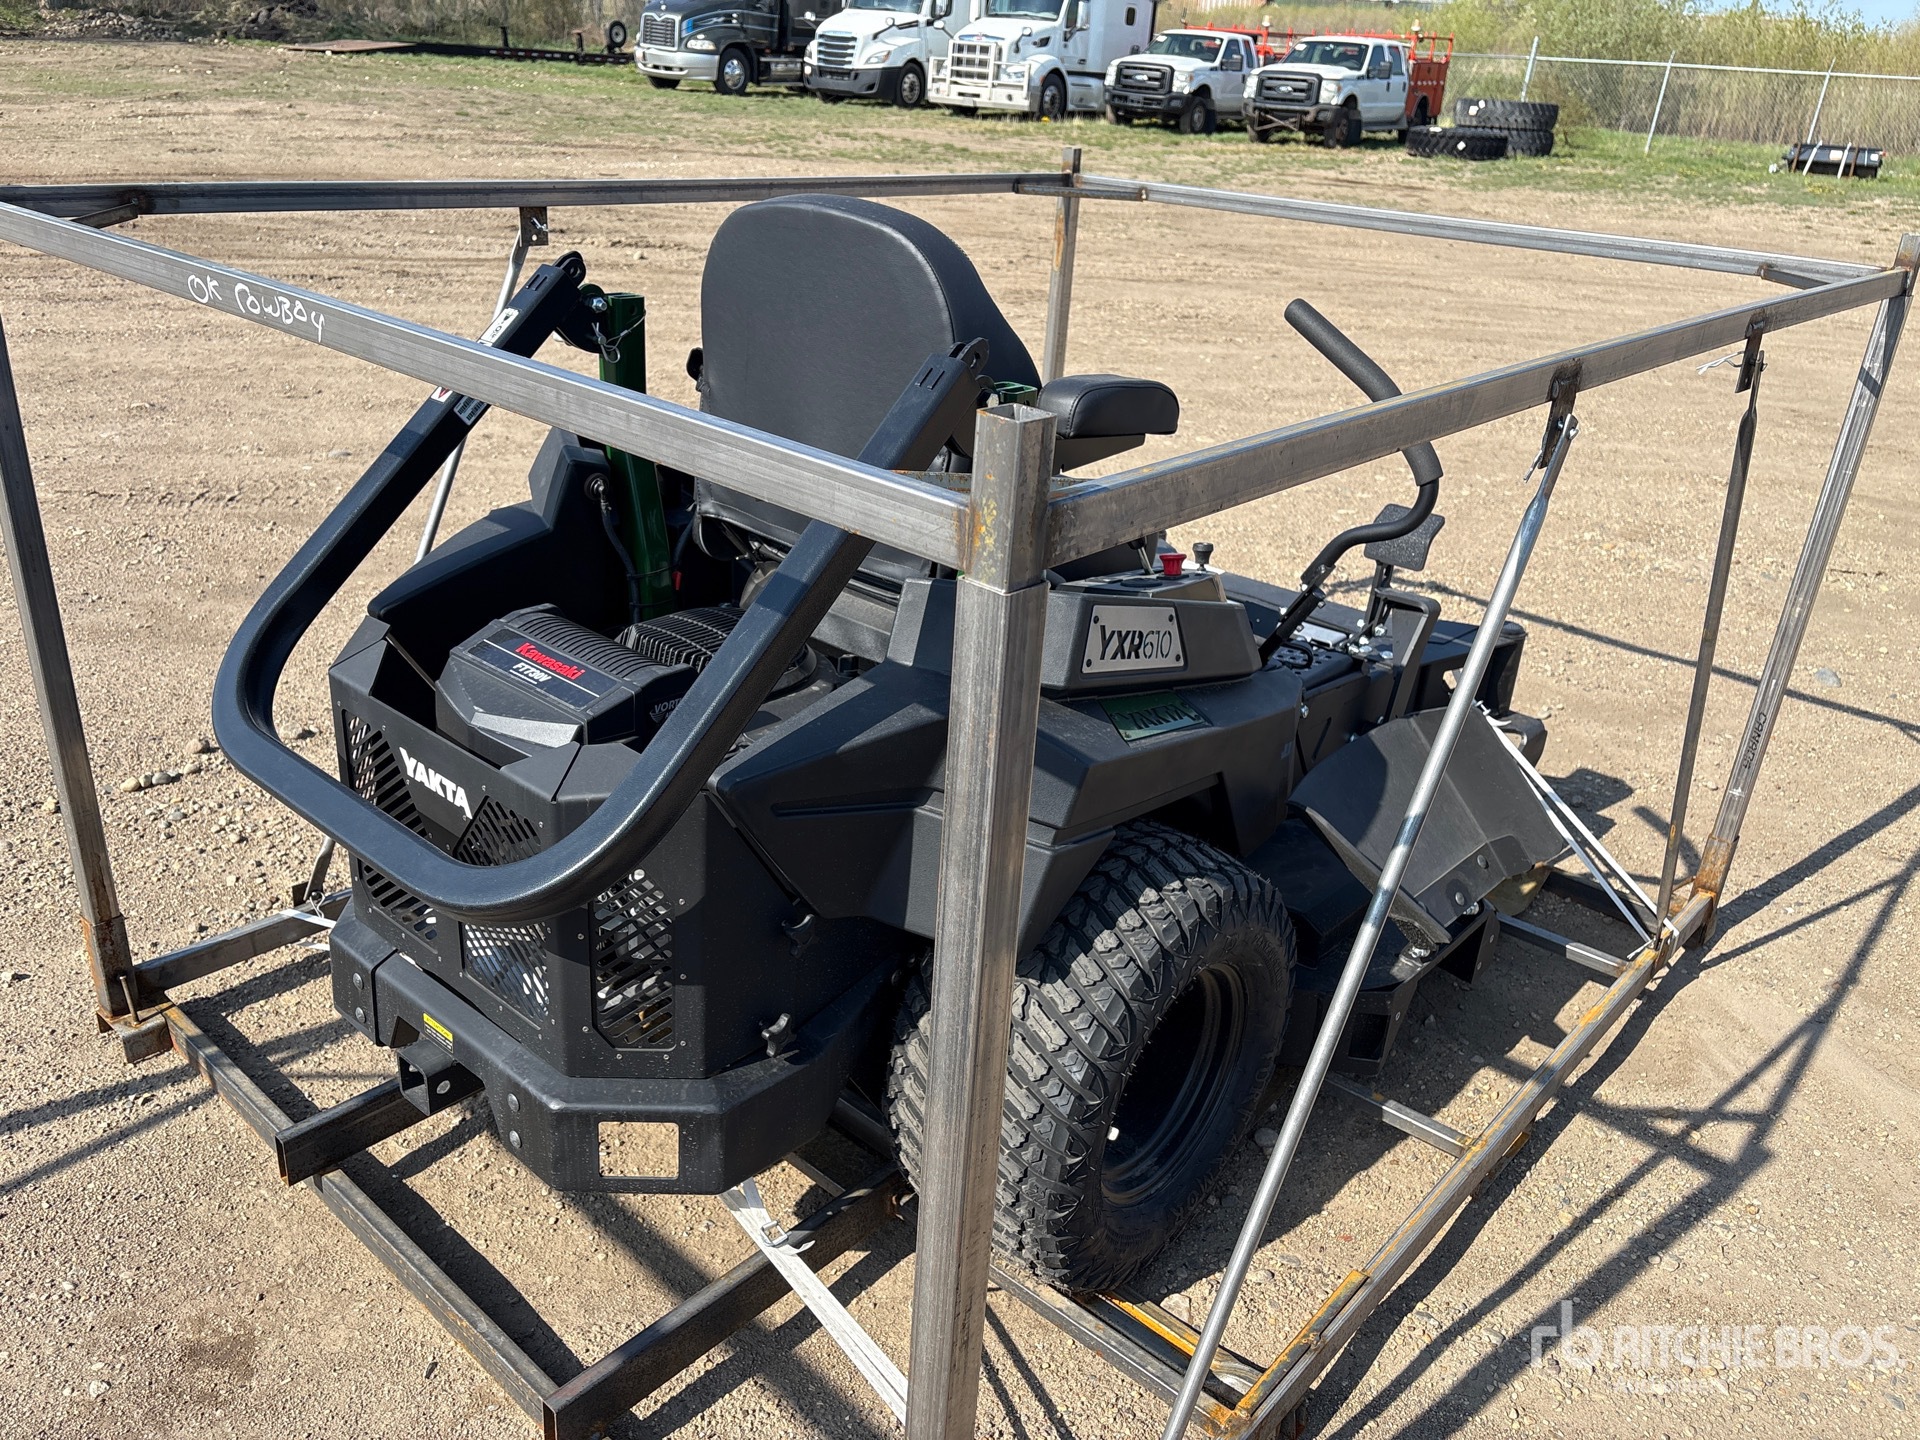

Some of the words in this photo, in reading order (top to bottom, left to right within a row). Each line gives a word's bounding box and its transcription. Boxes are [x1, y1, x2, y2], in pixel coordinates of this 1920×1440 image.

[188, 275, 222, 303] OK
[1100, 625, 1172, 660] YXR610
[512, 662, 552, 682] FT730V
[515, 642, 586, 680] Kawasaki
[654, 698, 682, 714] VORT
[399, 746, 473, 820] YAKTA
